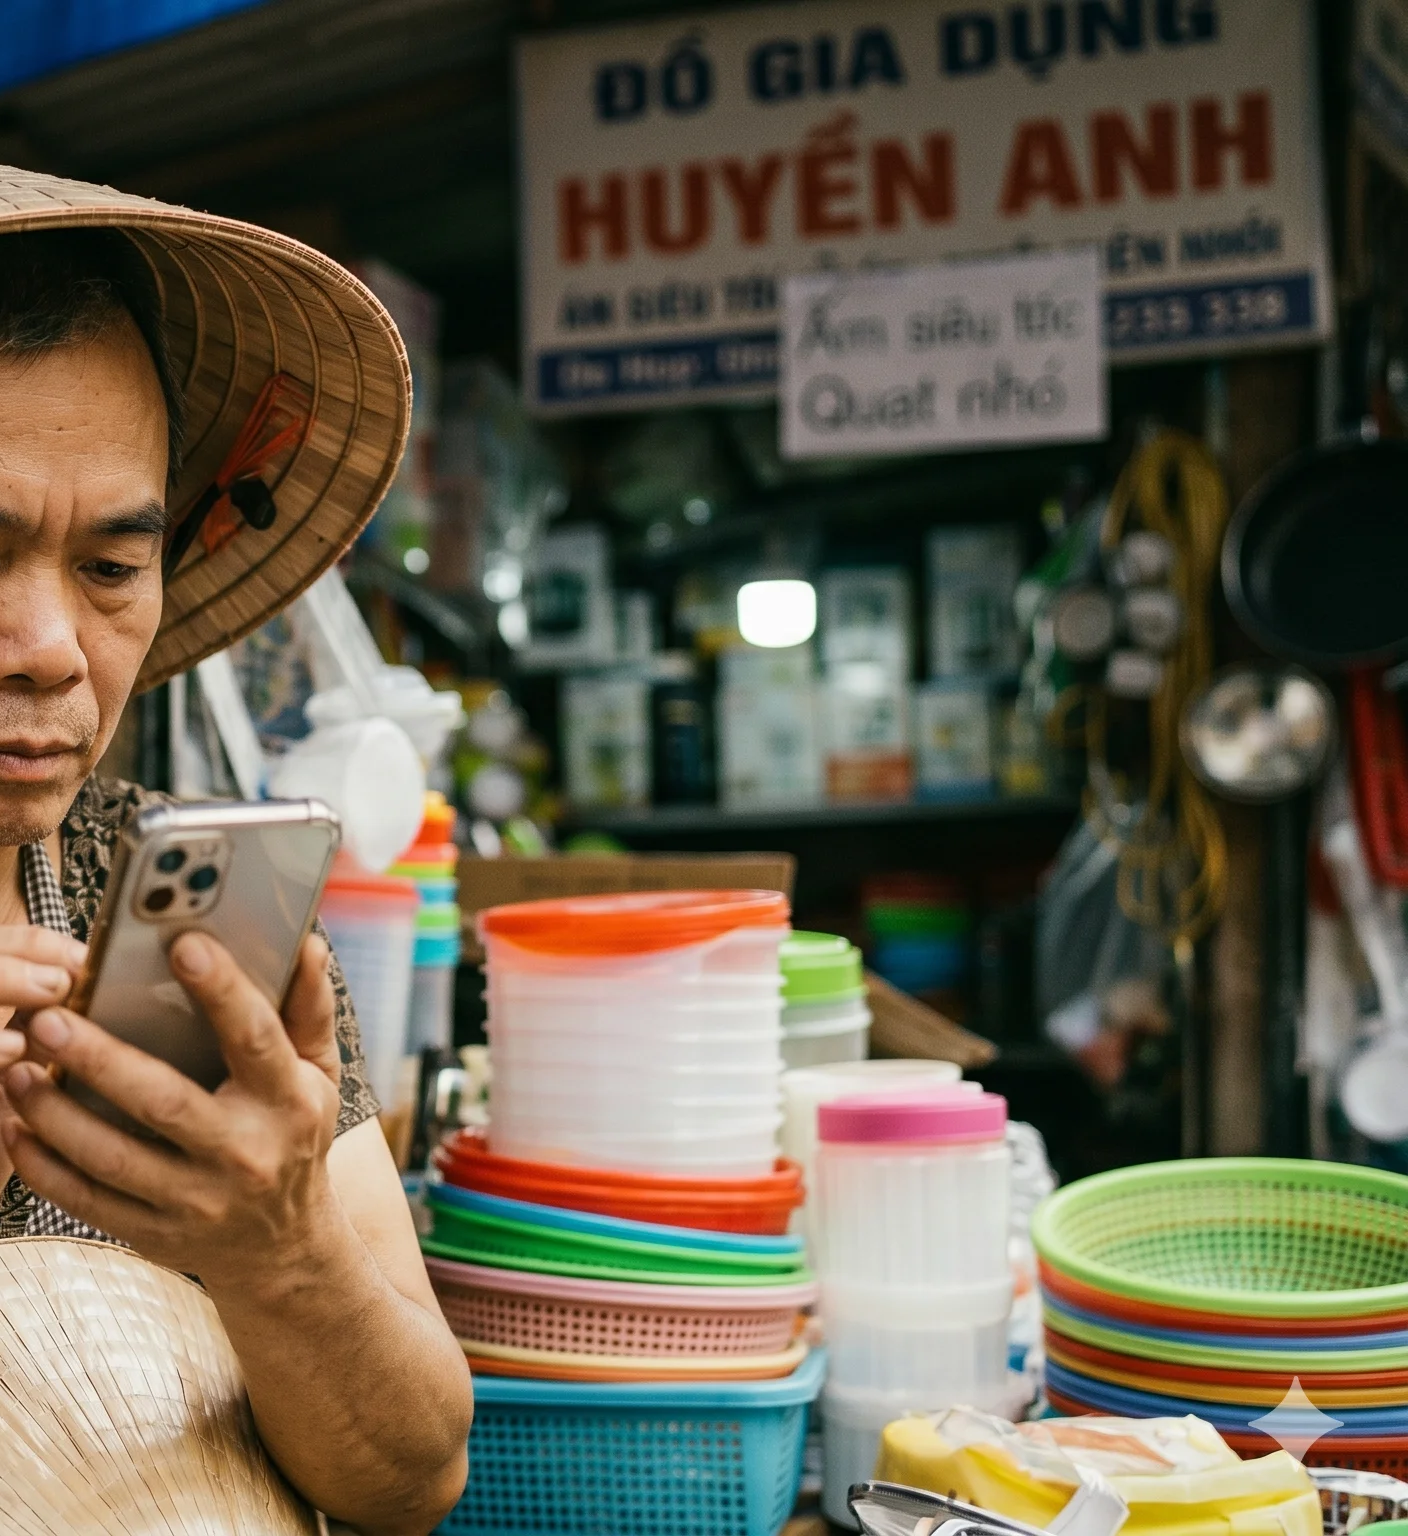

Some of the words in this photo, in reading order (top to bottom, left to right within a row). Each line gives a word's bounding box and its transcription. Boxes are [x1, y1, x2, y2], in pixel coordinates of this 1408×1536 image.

[748, 25, 905, 104] GIA
[940, 0, 1219, 84] DỤNG
[1000, 90, 1273, 218] ANH
